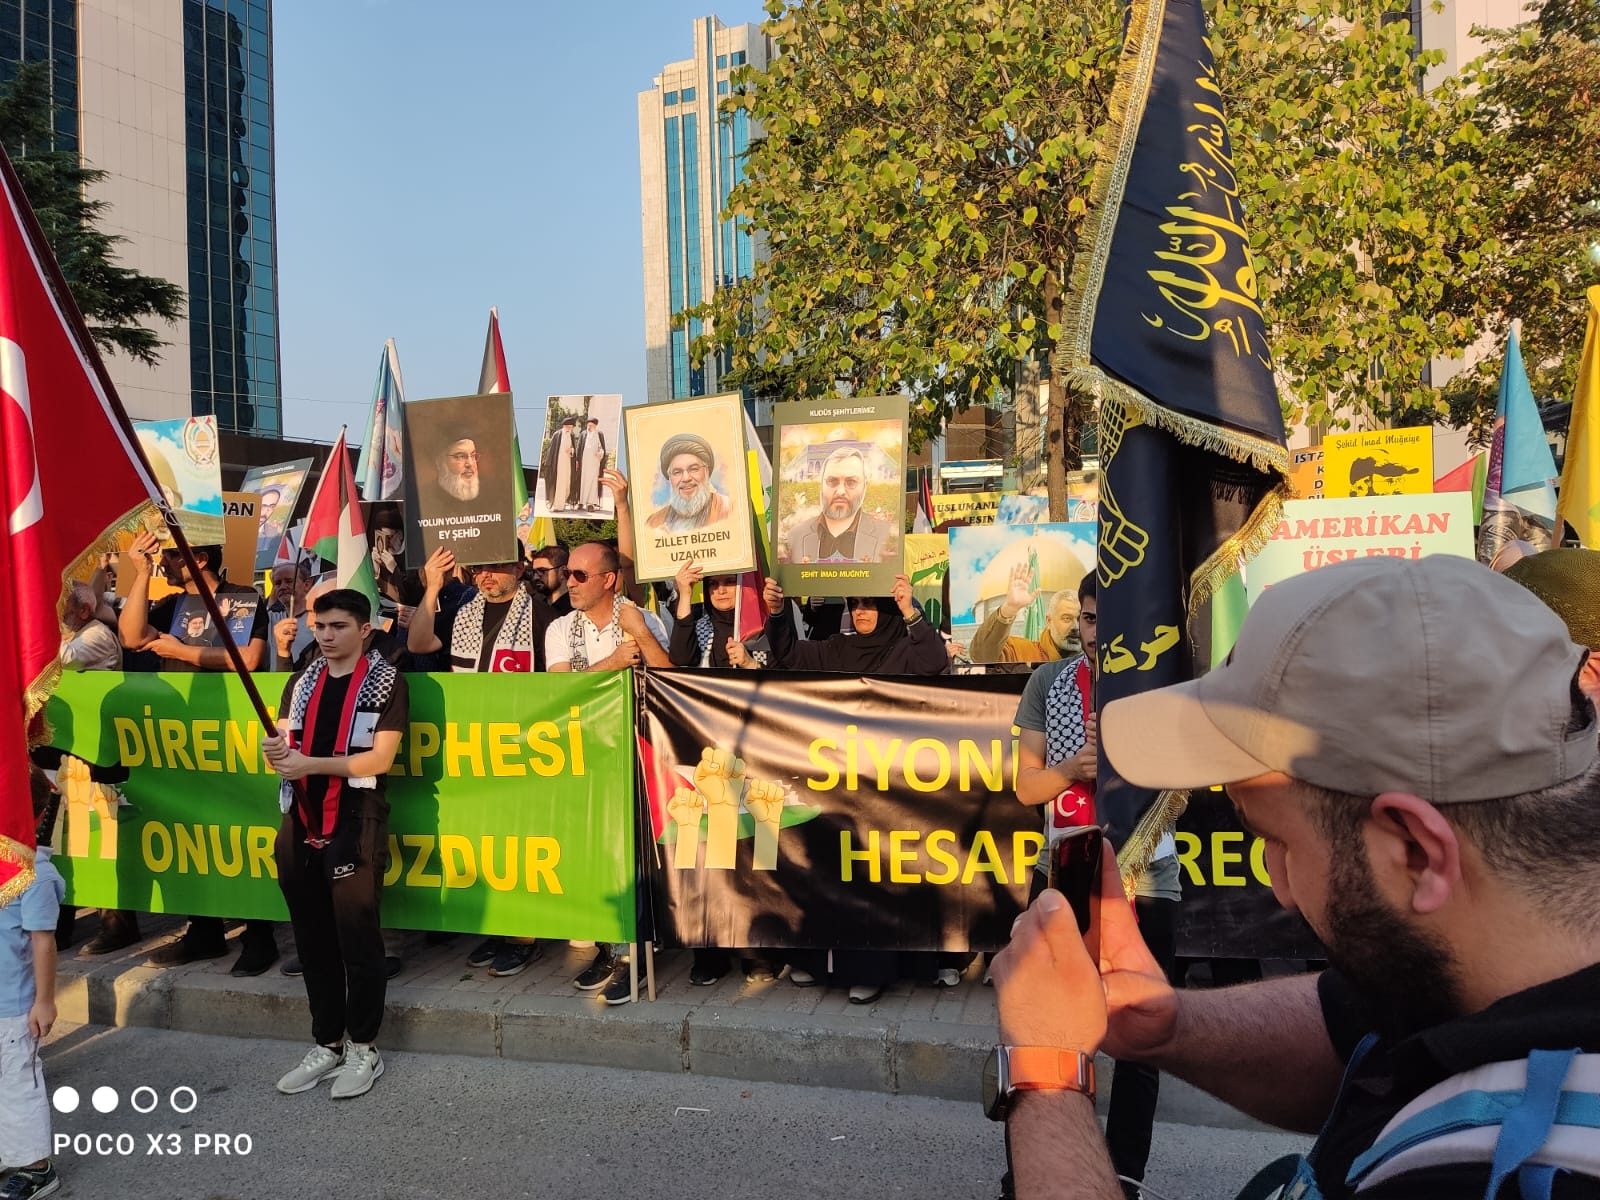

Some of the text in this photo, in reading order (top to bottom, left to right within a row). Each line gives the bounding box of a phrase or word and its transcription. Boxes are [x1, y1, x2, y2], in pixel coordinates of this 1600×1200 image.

[418, 514, 502, 527] YOLUN YOLUMUZDUR
[1269, 510, 1451, 541] AMERİKAN
[438, 527, 481, 541] EY ŞEHİD
[655, 530, 731, 549] ZİLLET BİZDEN
[670, 548, 717, 562] UZAKTIR
[807, 725, 1020, 792] SİYONİ
[840, 830, 1046, 885] HESAP
